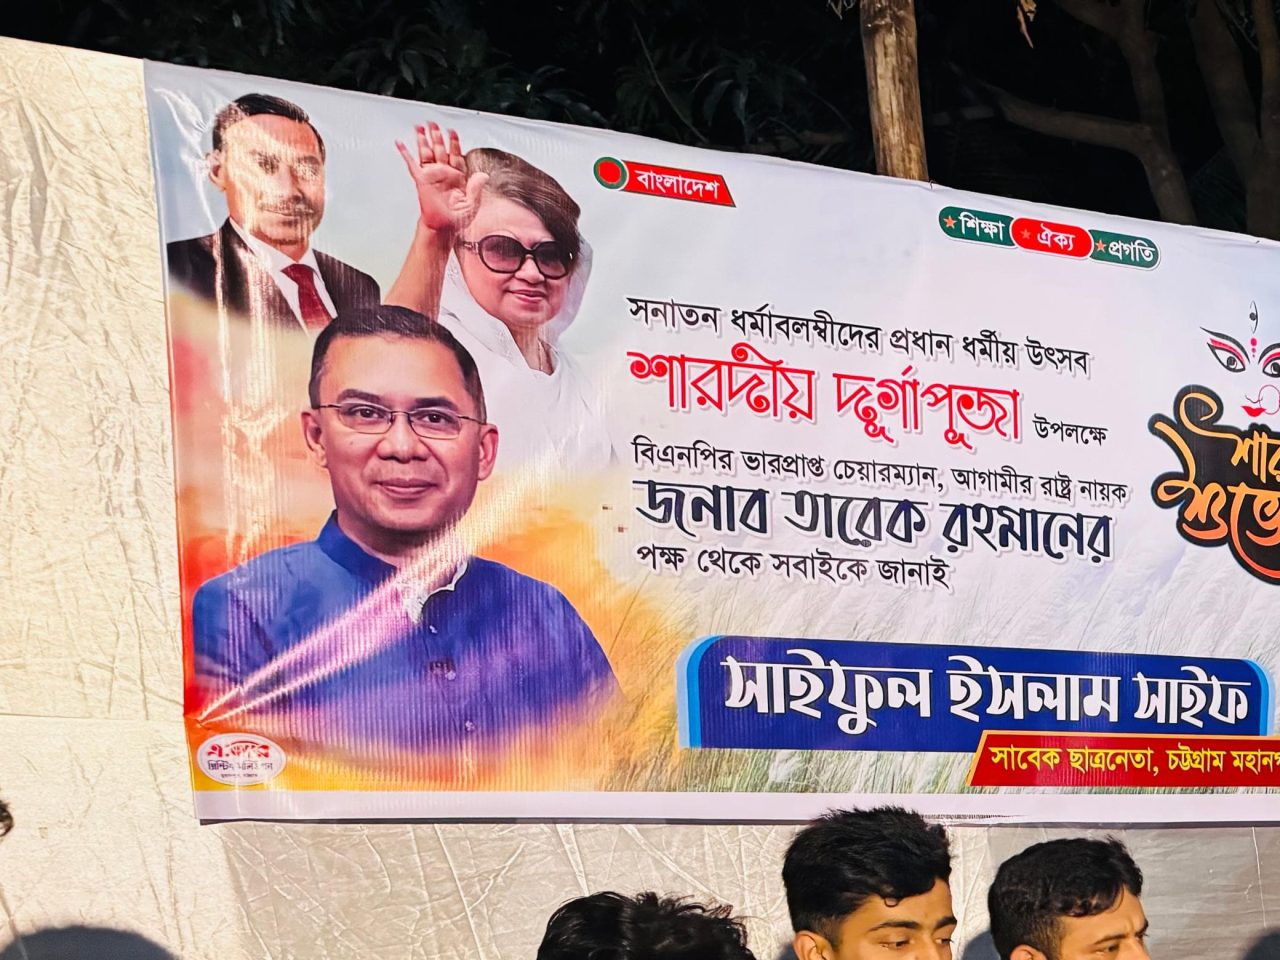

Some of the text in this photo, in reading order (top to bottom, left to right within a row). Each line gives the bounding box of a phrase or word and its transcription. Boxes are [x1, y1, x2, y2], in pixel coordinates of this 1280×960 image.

[634, 169, 720, 199] বাংলাদেশ
[958, 211, 1156, 263] শিক্ষা ঐক্য প্রগতি
[626, 297, 1091, 376] সনাতন ধর্মাবলম্বীদের প্রধান ধর্মীয় উৎসব
[626, 341, 816, 421] শারদীয়
[1033, 414, 1108, 448] উপলক্ষে
[631, 434, 1129, 504] বিএনপির ভারপ্রাপ্ত চেয়ারম্যান, আগামীর রাষ্ট্র নায়ক
[631, 478, 1113, 563] জনাব তারেক রহমানের
[636, 543, 954, 592] পক্ষ থেকে সবাইকে জানাই
[720, 648, 1252, 736] সাইফুল ইসলাম সাইফ
[988, 743, 1063, 771] সাবেক
[1066, 745, 1160, 777] ছাত্রনেতা,
[1166, 741, 1226, 773] চট্টগ্রাম
